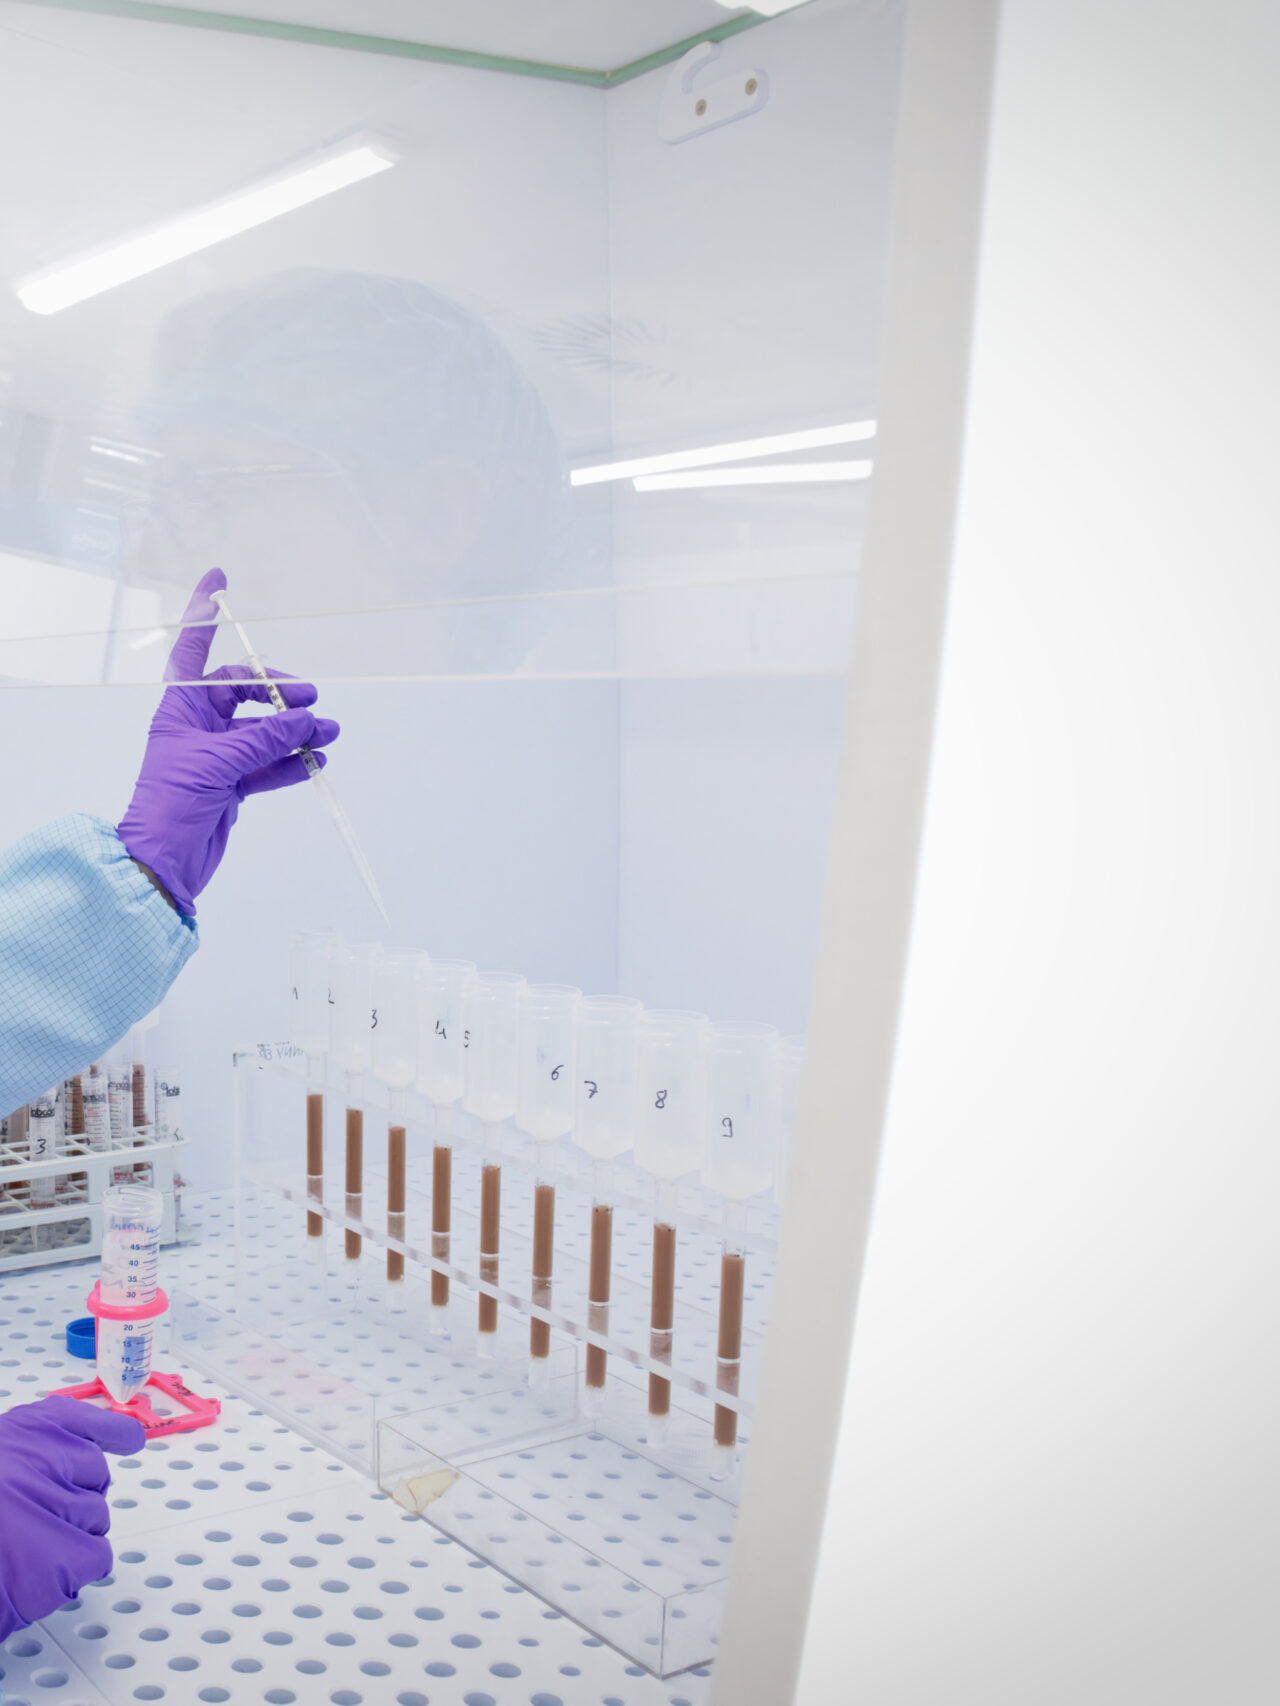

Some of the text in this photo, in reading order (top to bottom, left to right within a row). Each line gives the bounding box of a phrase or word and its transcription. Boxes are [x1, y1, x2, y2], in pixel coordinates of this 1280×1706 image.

[370, 1008, 378, 1029] 3
[435, 1020, 447, 1040] 4
[551, 1064, 564, 1081] 6
[583, 1080, 598, 1099] 7
[654, 1089, 667, 1109] 8
[721, 1116, 733, 1138] 9
[35, 1138, 47, 1155] 3
[127, 1275, 138, 1283] 35
